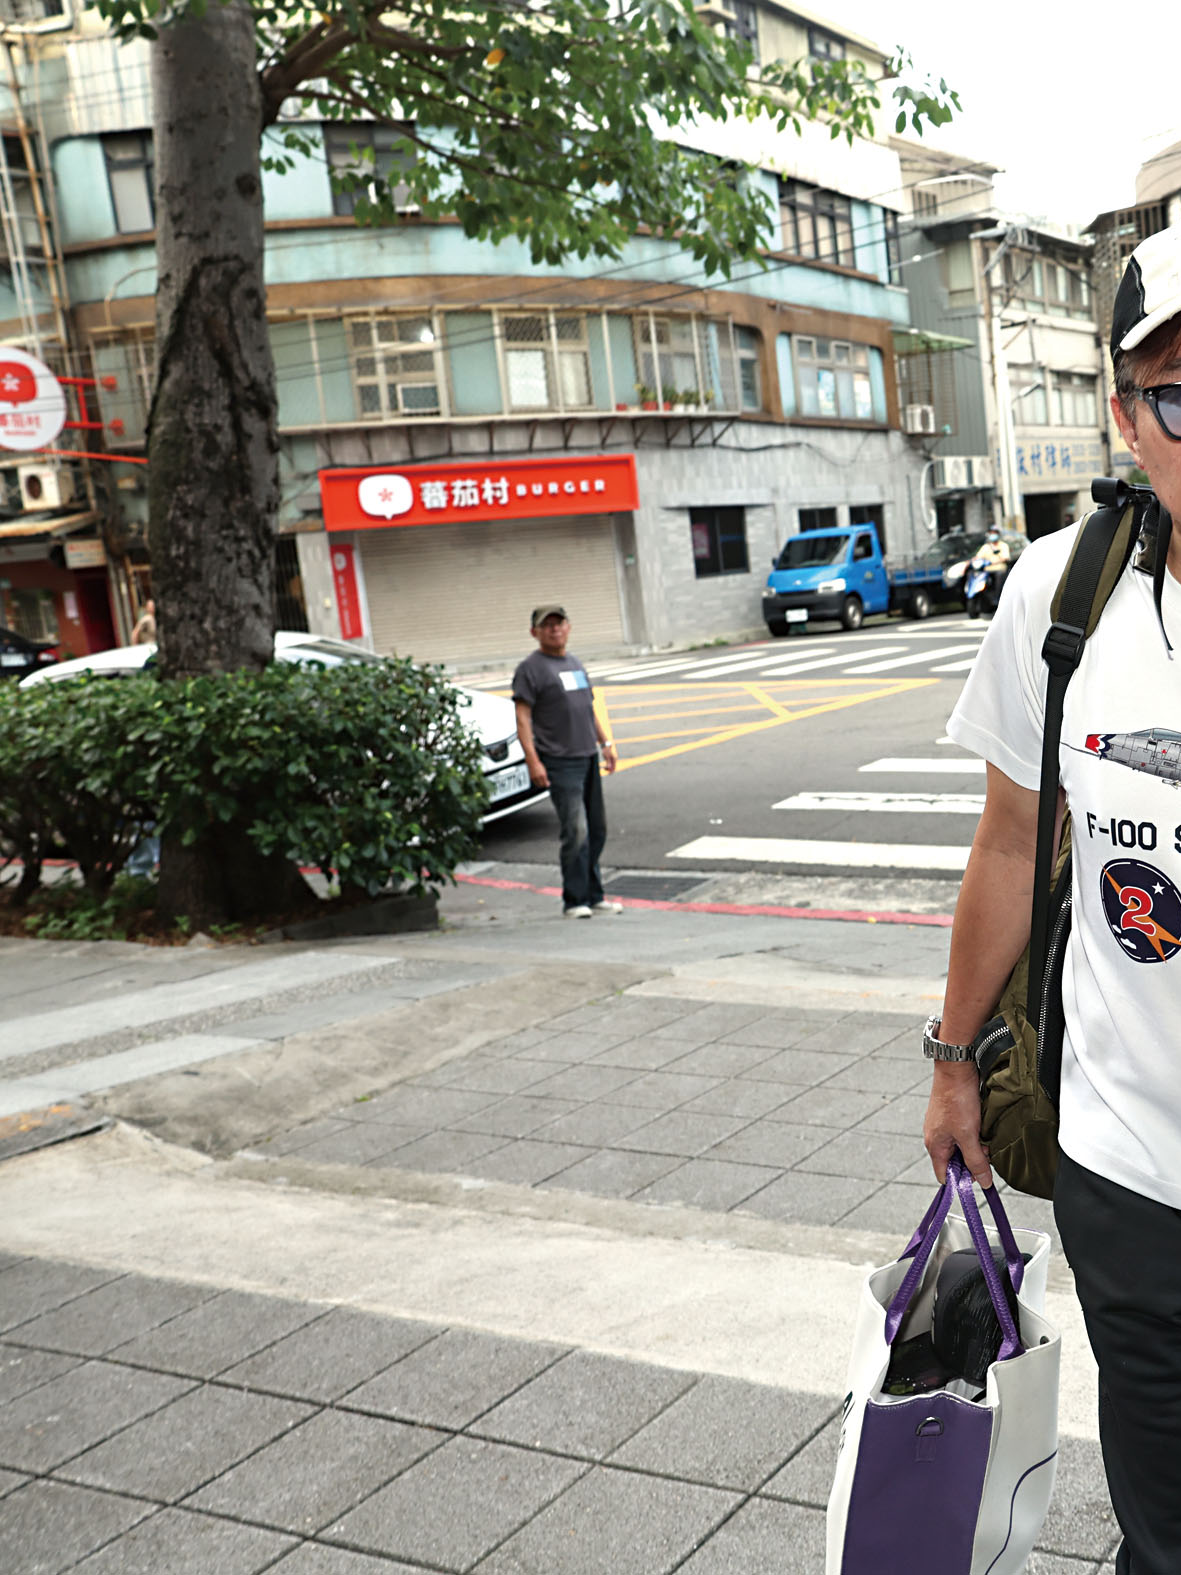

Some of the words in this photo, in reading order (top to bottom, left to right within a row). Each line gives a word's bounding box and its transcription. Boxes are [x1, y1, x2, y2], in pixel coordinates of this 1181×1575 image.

[420, 476, 510, 510] 蕃茄村
[516, 479, 606, 497] BURGER
[1086, 811, 1157, 850] F-100
[1119, 886, 1157, 936] 2
